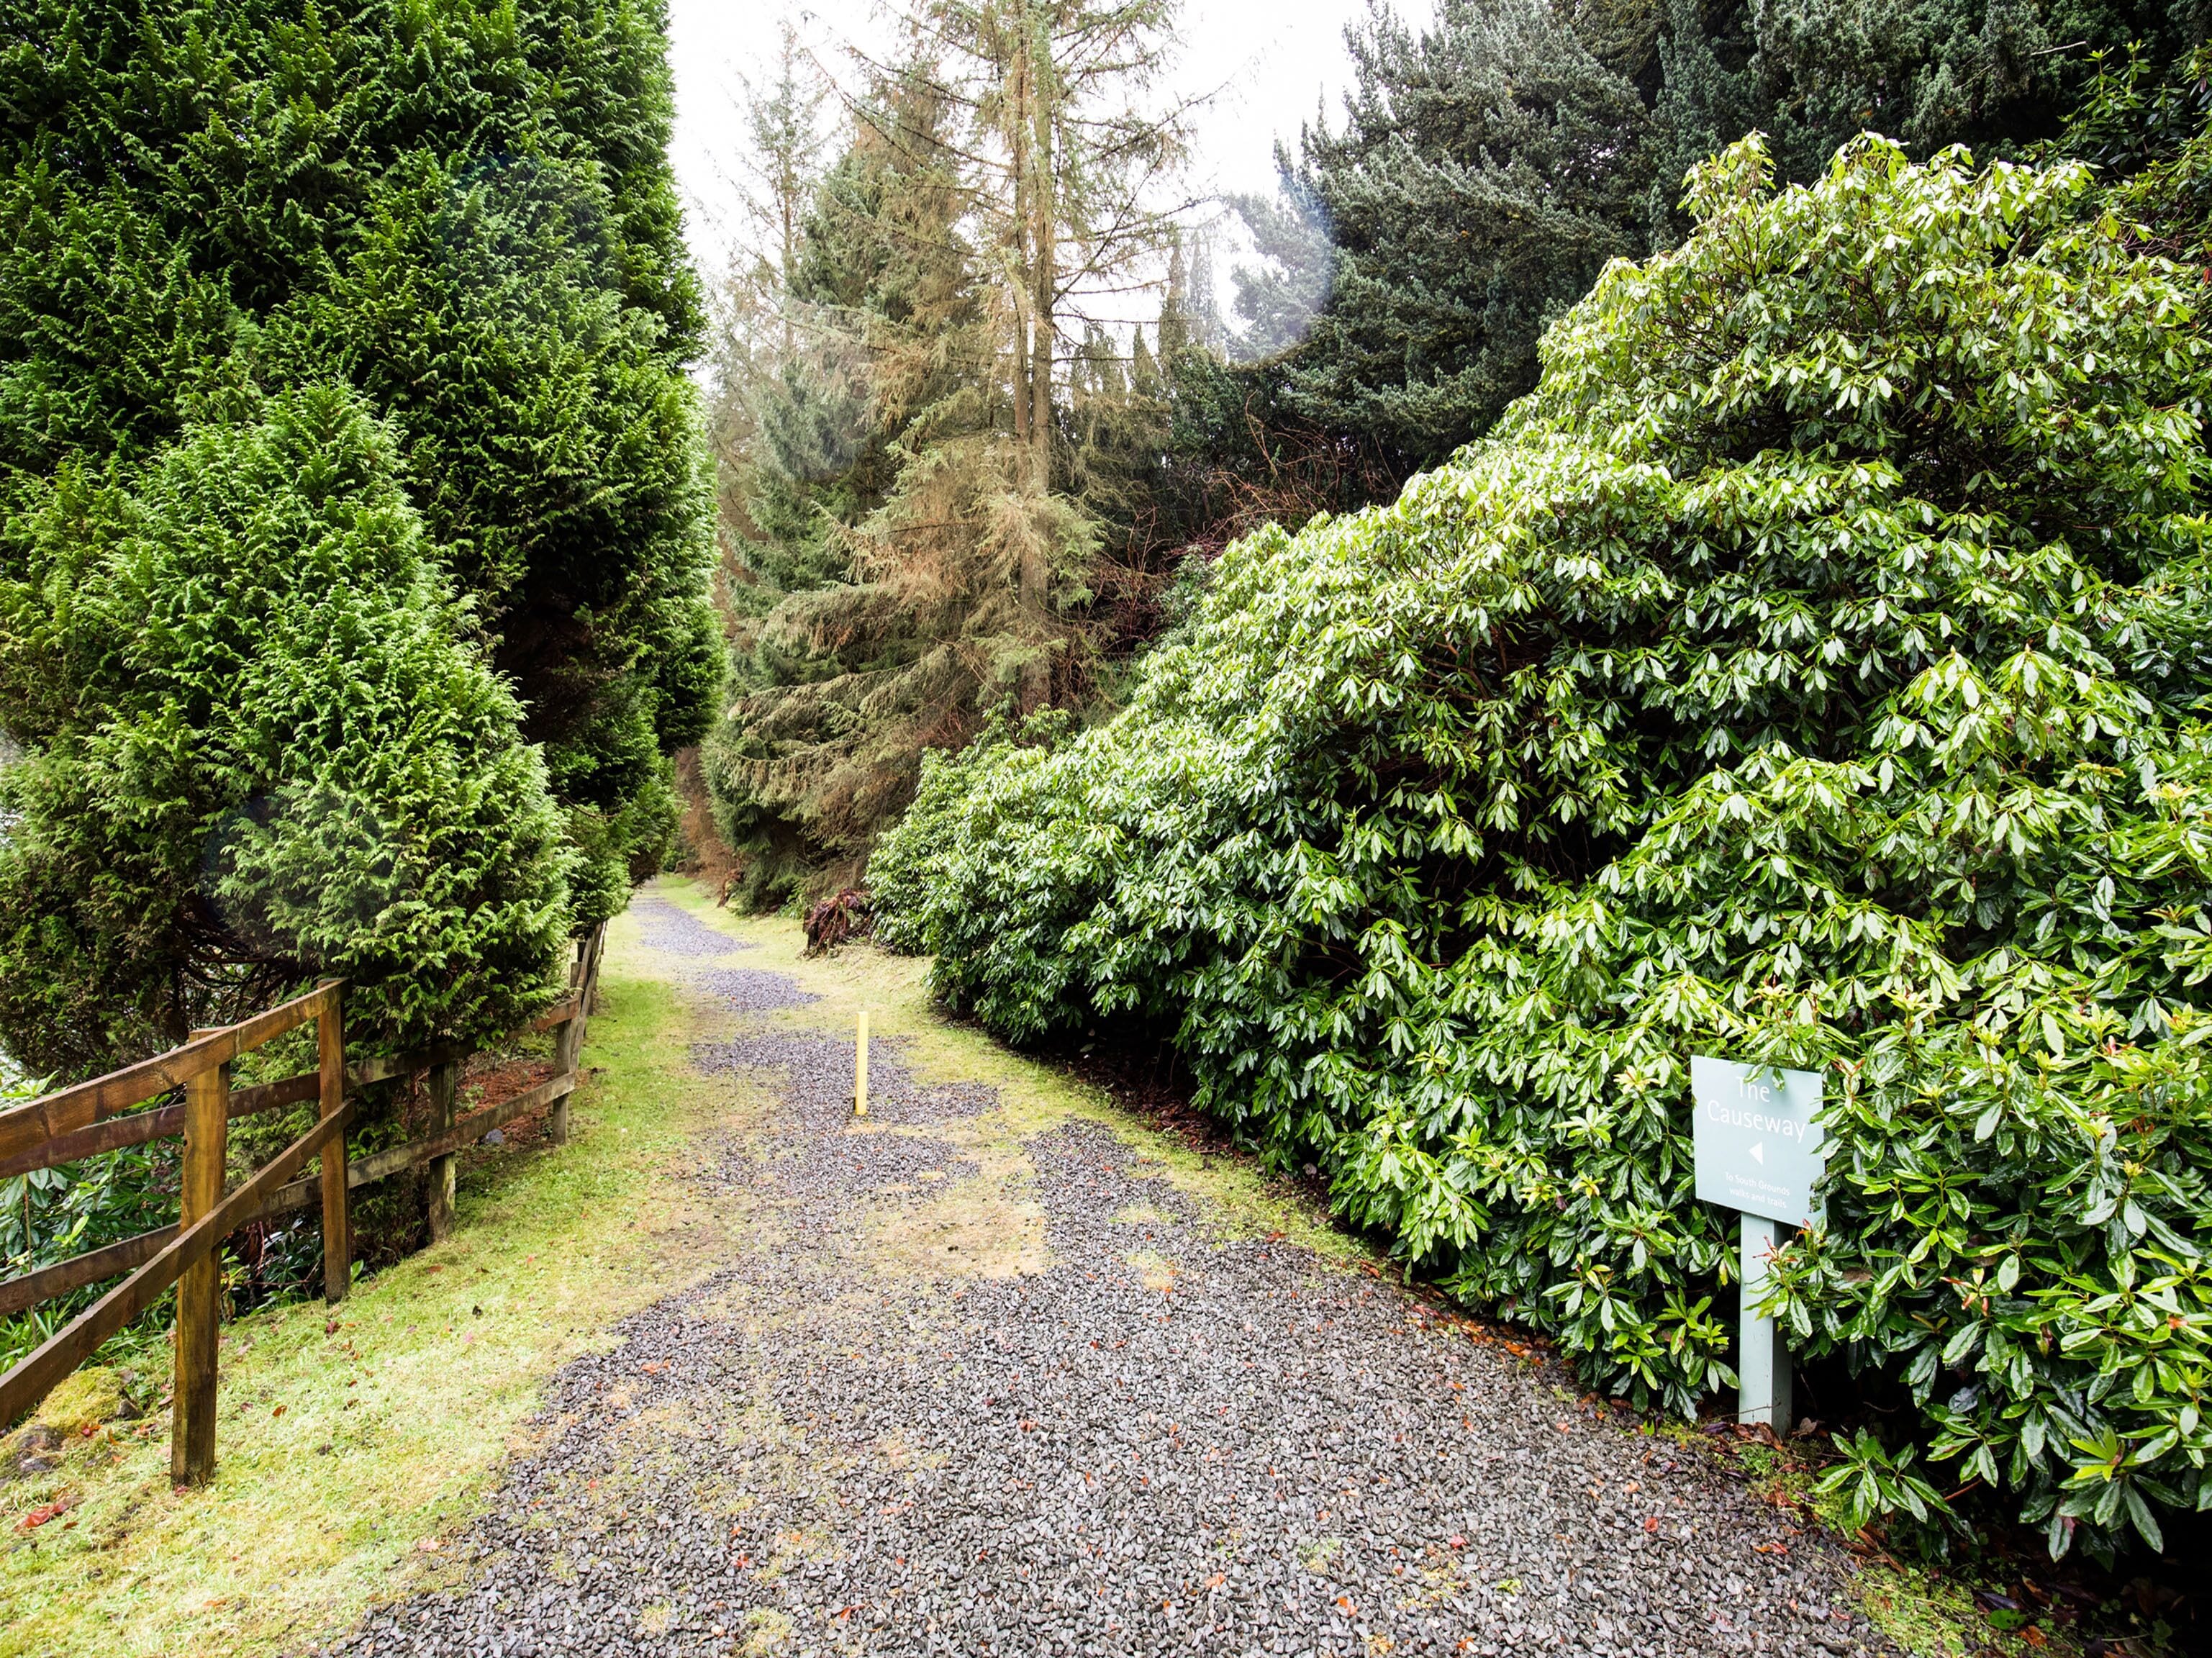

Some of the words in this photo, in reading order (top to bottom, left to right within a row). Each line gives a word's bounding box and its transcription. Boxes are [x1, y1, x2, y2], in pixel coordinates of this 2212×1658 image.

[1736, 1076, 1770, 1102] The
[1707, 1100, 1806, 1143] Causeway
[1725, 1172, 1733, 1182] To
[1735, 1174, 1757, 1187] South
[1759, 1180, 1790, 1196] Grounds
[1729, 1187, 1750, 1199] walks
[1751, 1191, 1765, 1202] and
[1767, 1195, 1787, 1209] trails
